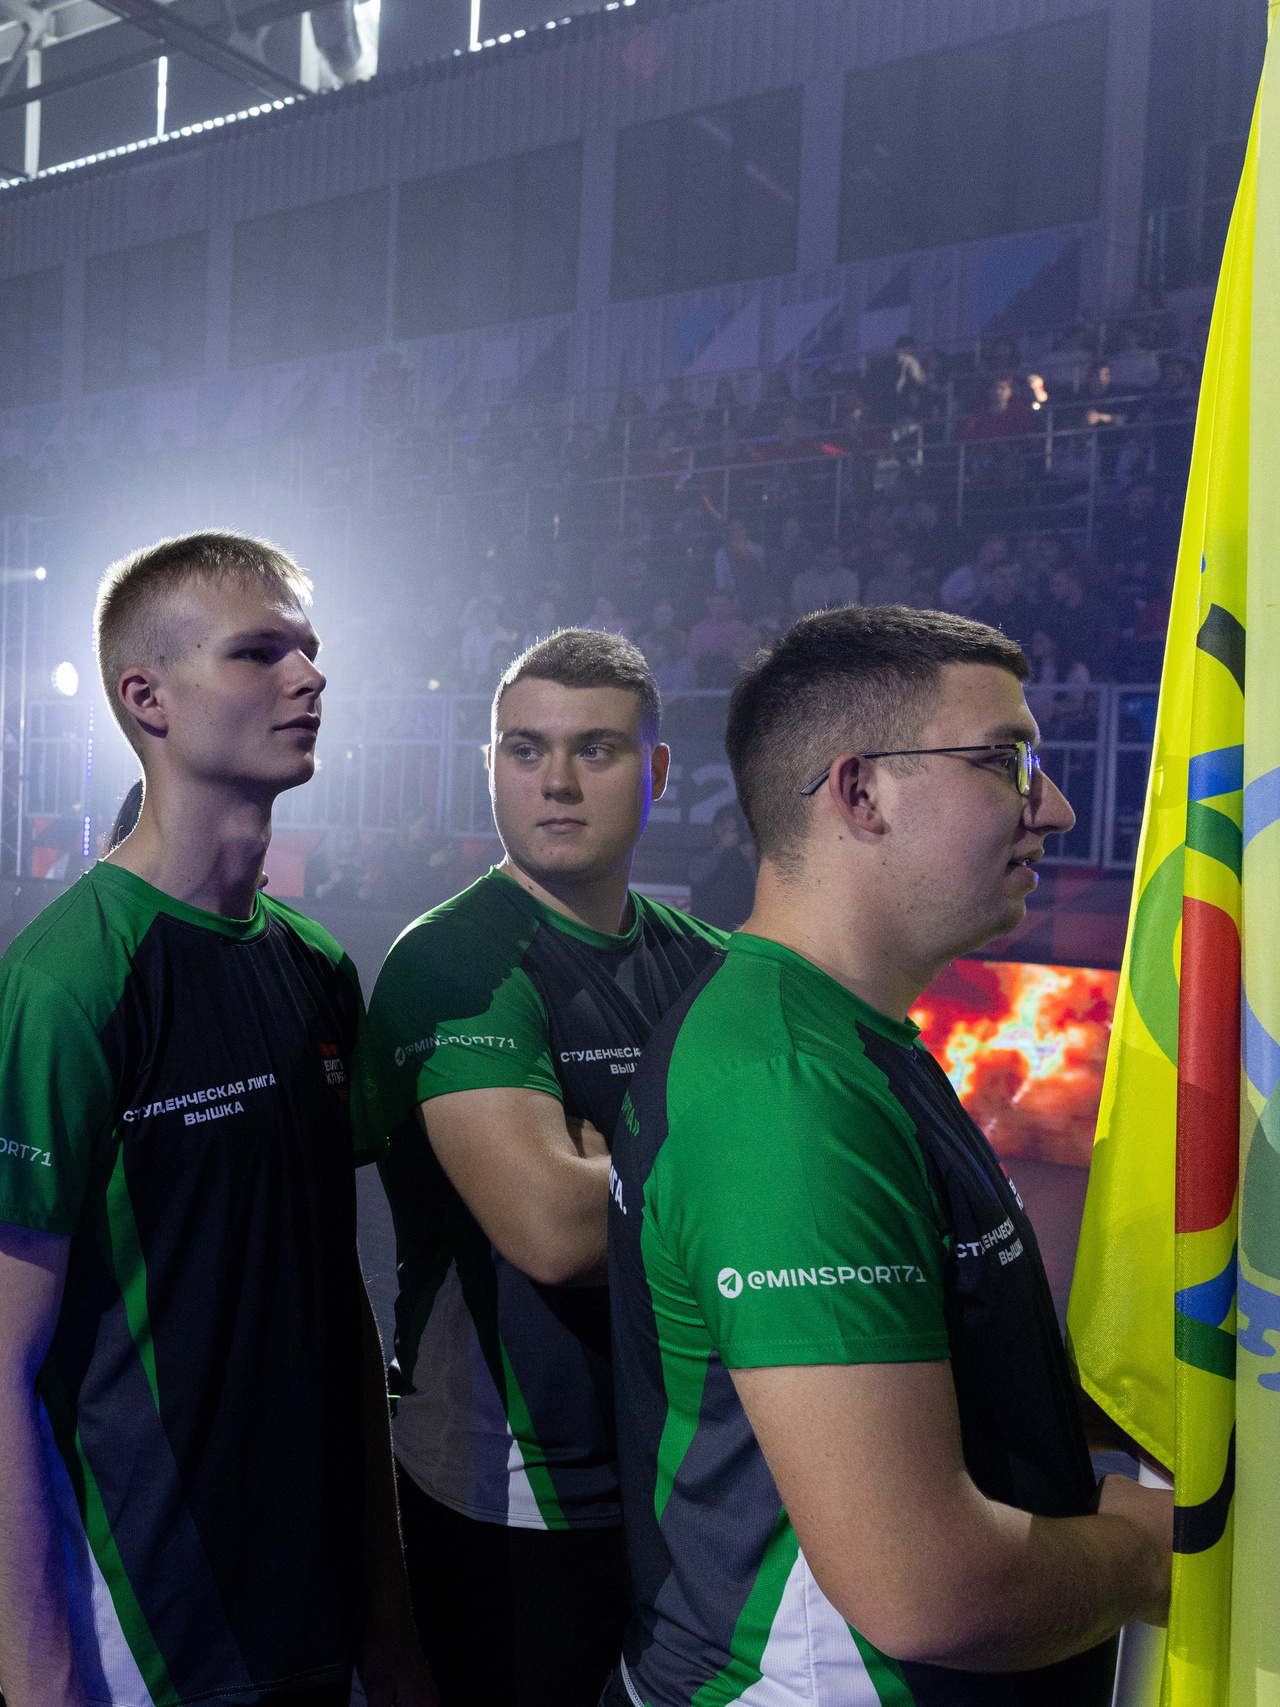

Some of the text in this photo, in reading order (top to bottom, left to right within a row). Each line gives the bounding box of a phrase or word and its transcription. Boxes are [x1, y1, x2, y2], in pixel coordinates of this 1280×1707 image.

[122, 1080, 246, 1123] СТУДЕНЧЕСКАЯ
[183, 1100, 245, 1126] ВЫШКА
[747, 1265, 927, 1290] @MINSPORT71
